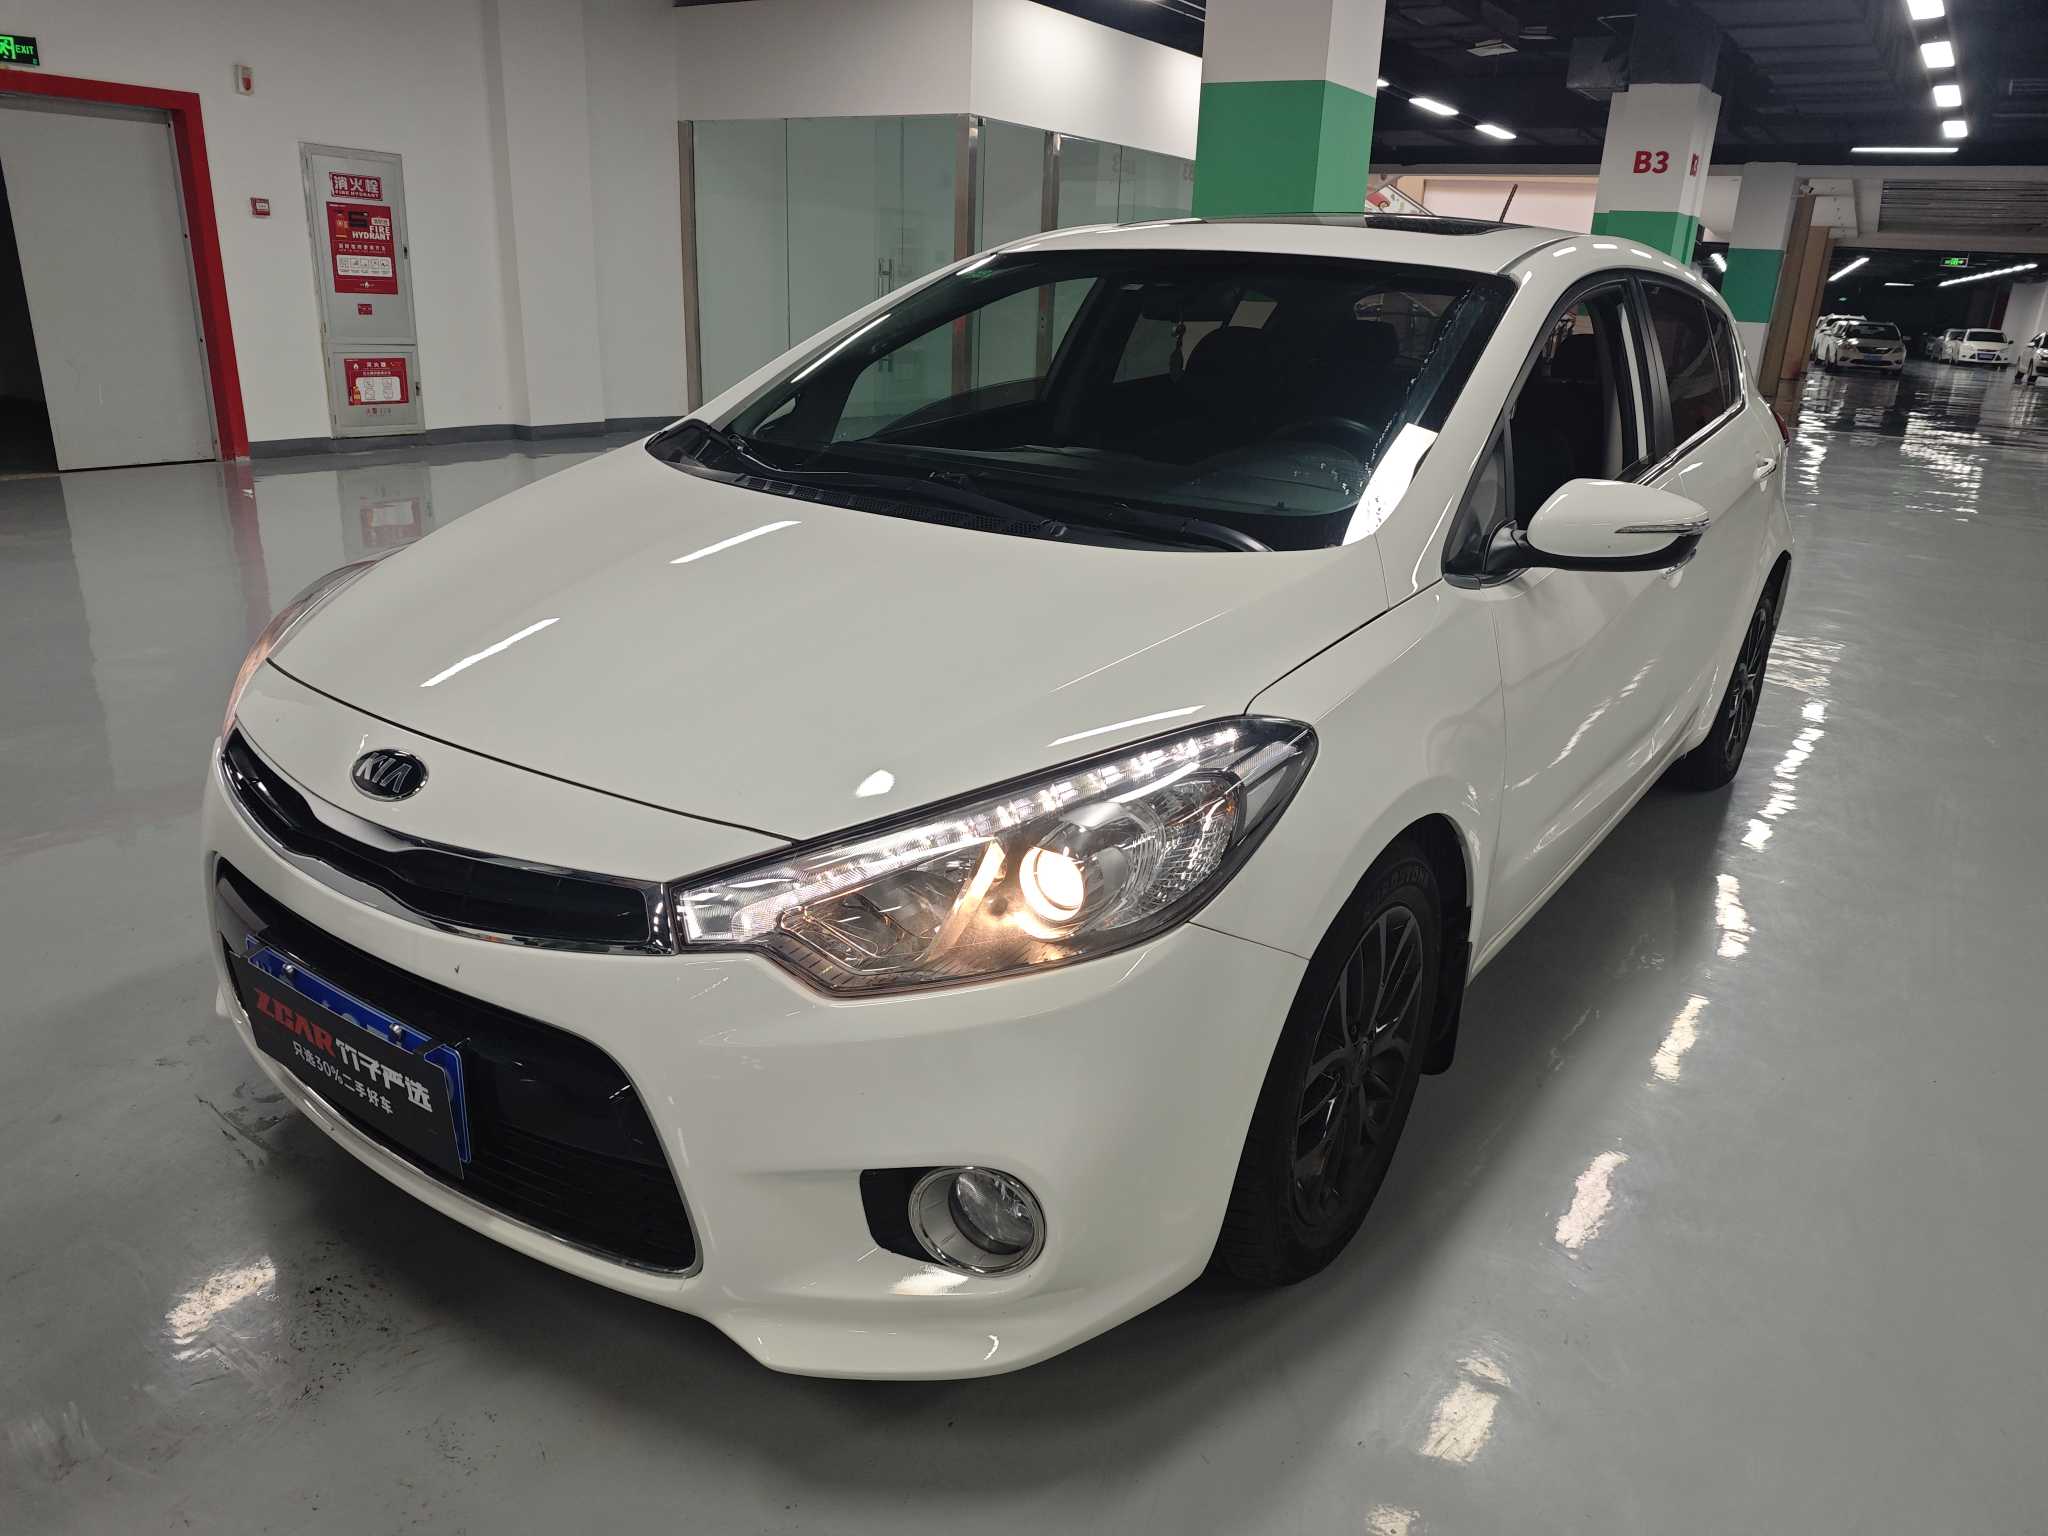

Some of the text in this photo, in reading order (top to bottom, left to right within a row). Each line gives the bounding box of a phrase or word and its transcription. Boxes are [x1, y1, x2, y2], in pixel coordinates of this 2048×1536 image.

[16, 45, 34, 55] EXIT
[1632, 150, 1670, 174] B3
[333, 175, 380, 194] 消火栓
[351, 231, 391, 241] HYDRANT
[369, 225, 391, 235] FIRE
[255, 986, 335, 1057] ZCAR
